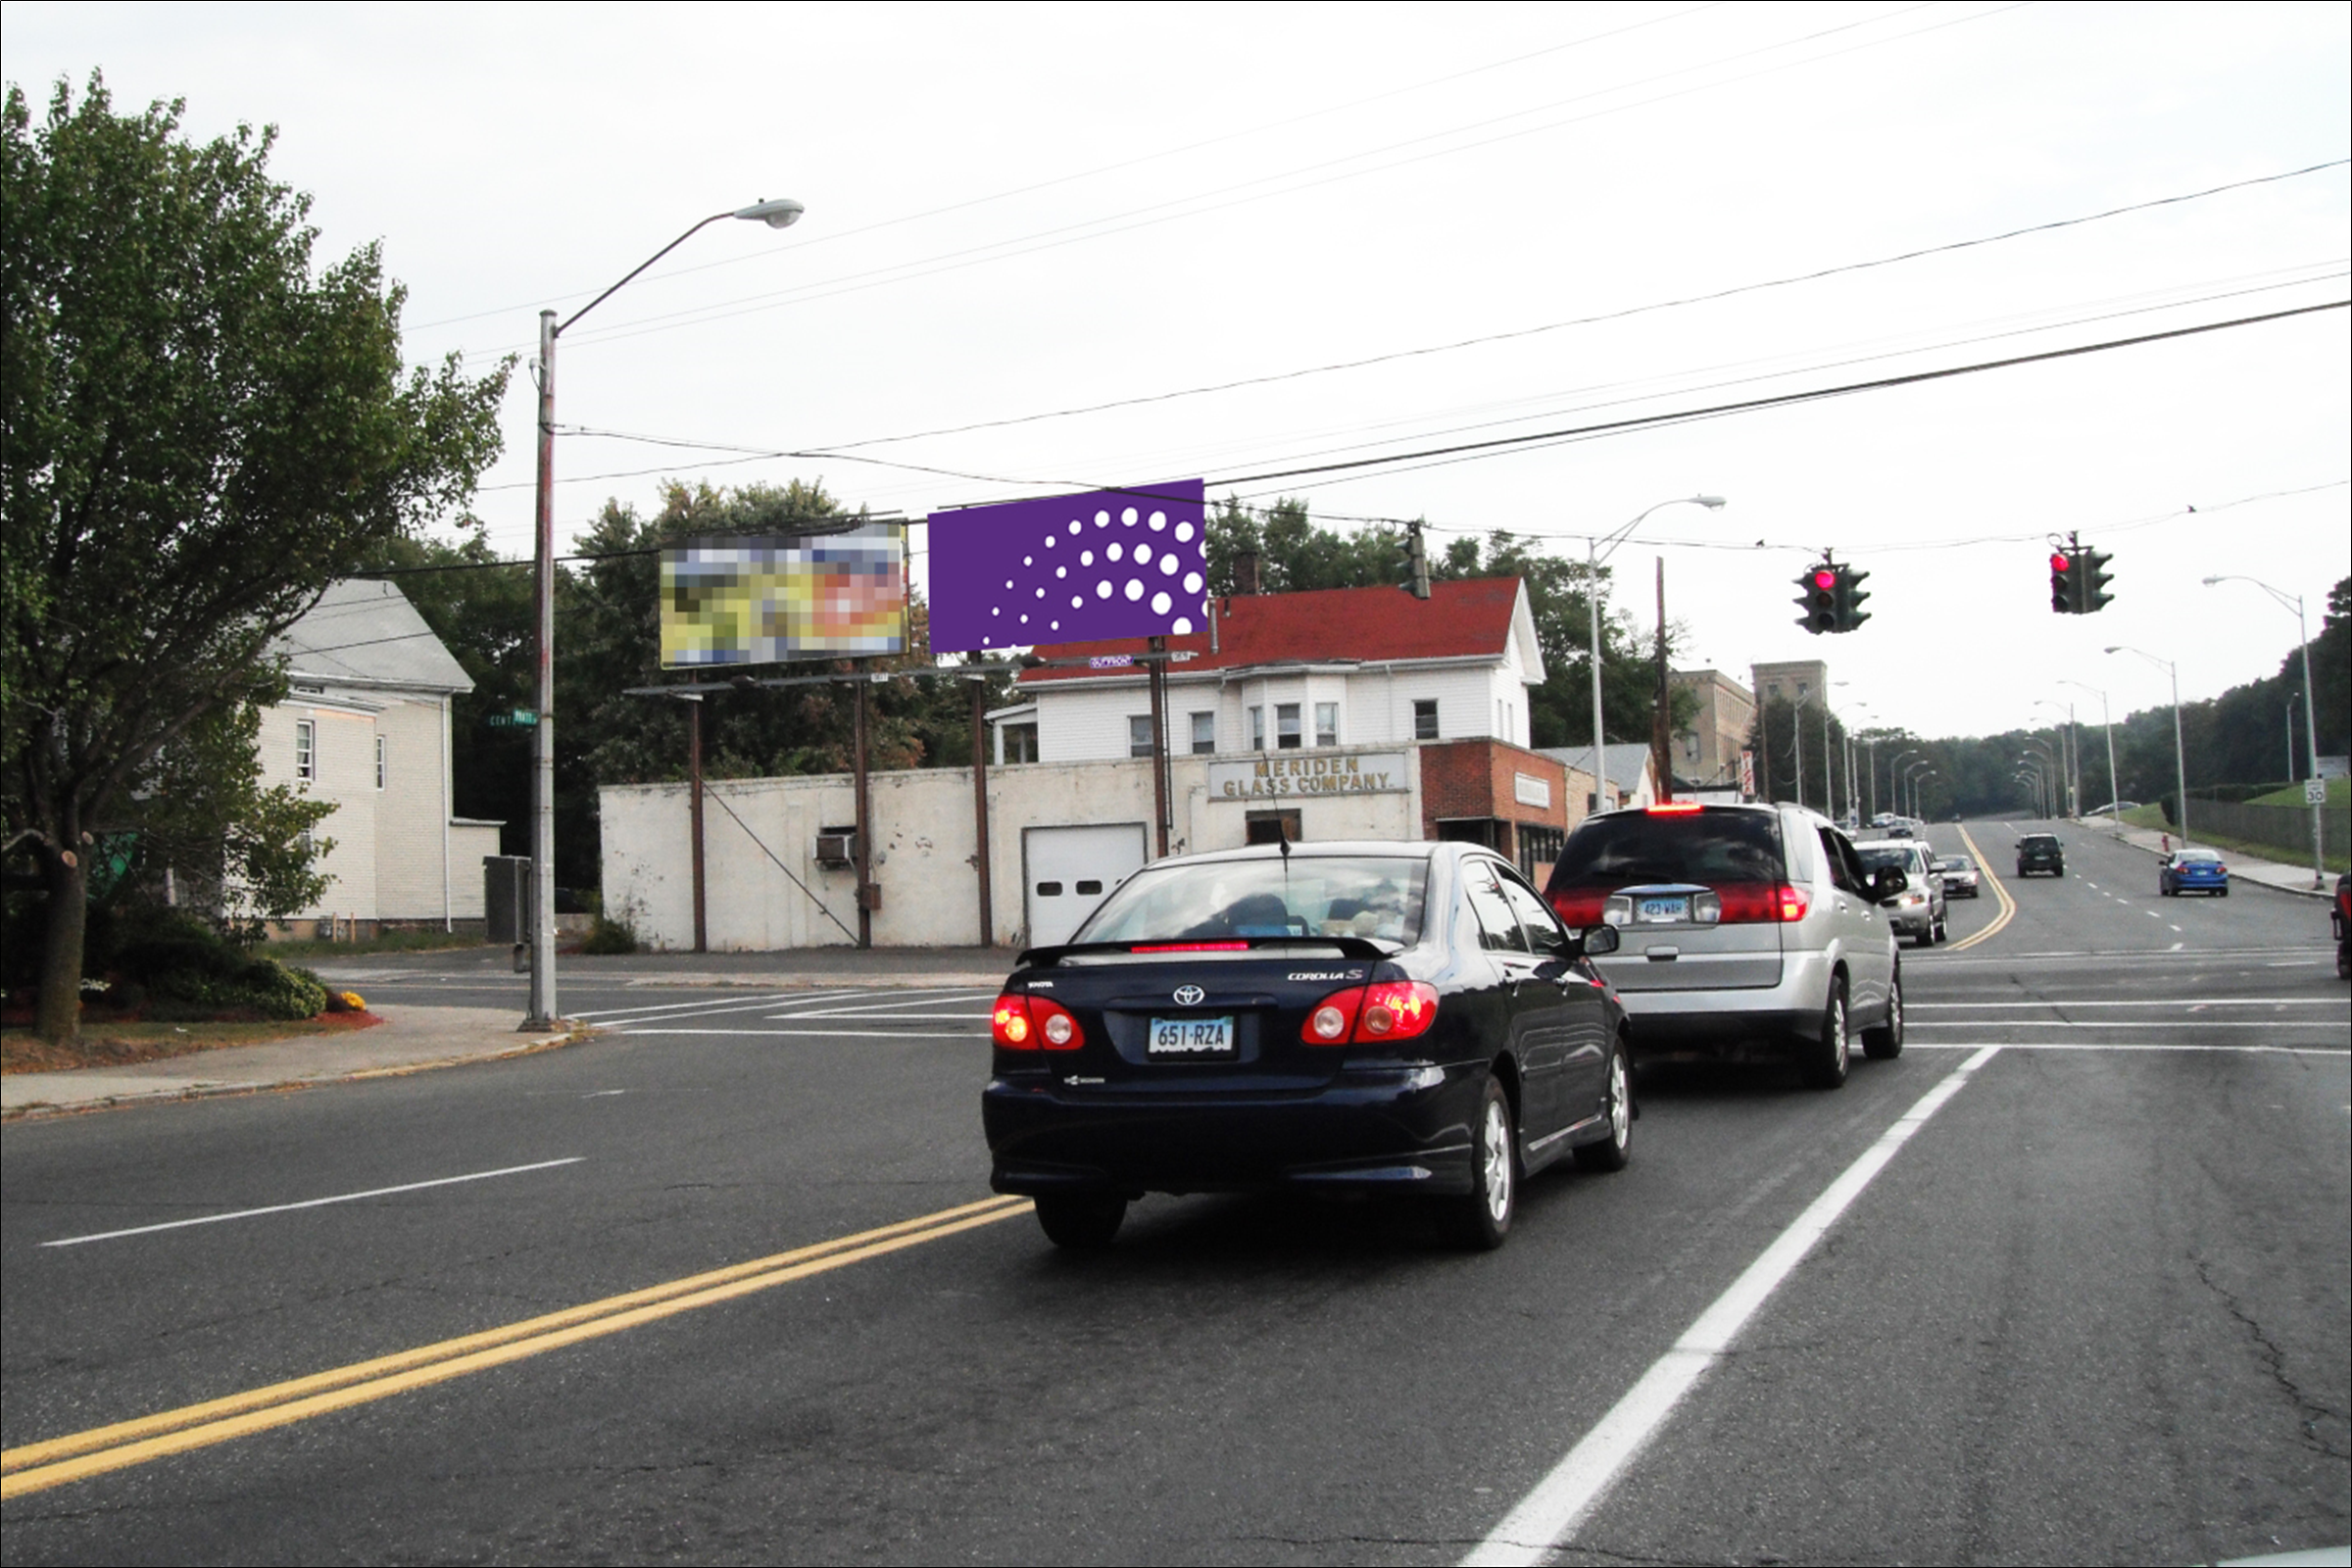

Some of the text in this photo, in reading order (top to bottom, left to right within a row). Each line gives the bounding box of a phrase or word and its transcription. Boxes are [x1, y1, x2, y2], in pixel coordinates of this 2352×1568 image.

[1254, 757, 1358, 777] MERIDEN
[1223, 772, 1390, 796] GLASS COMPANY
[2308, 791, 2324, 802] 30
[1288, 969, 1363, 981] COROLLA S
